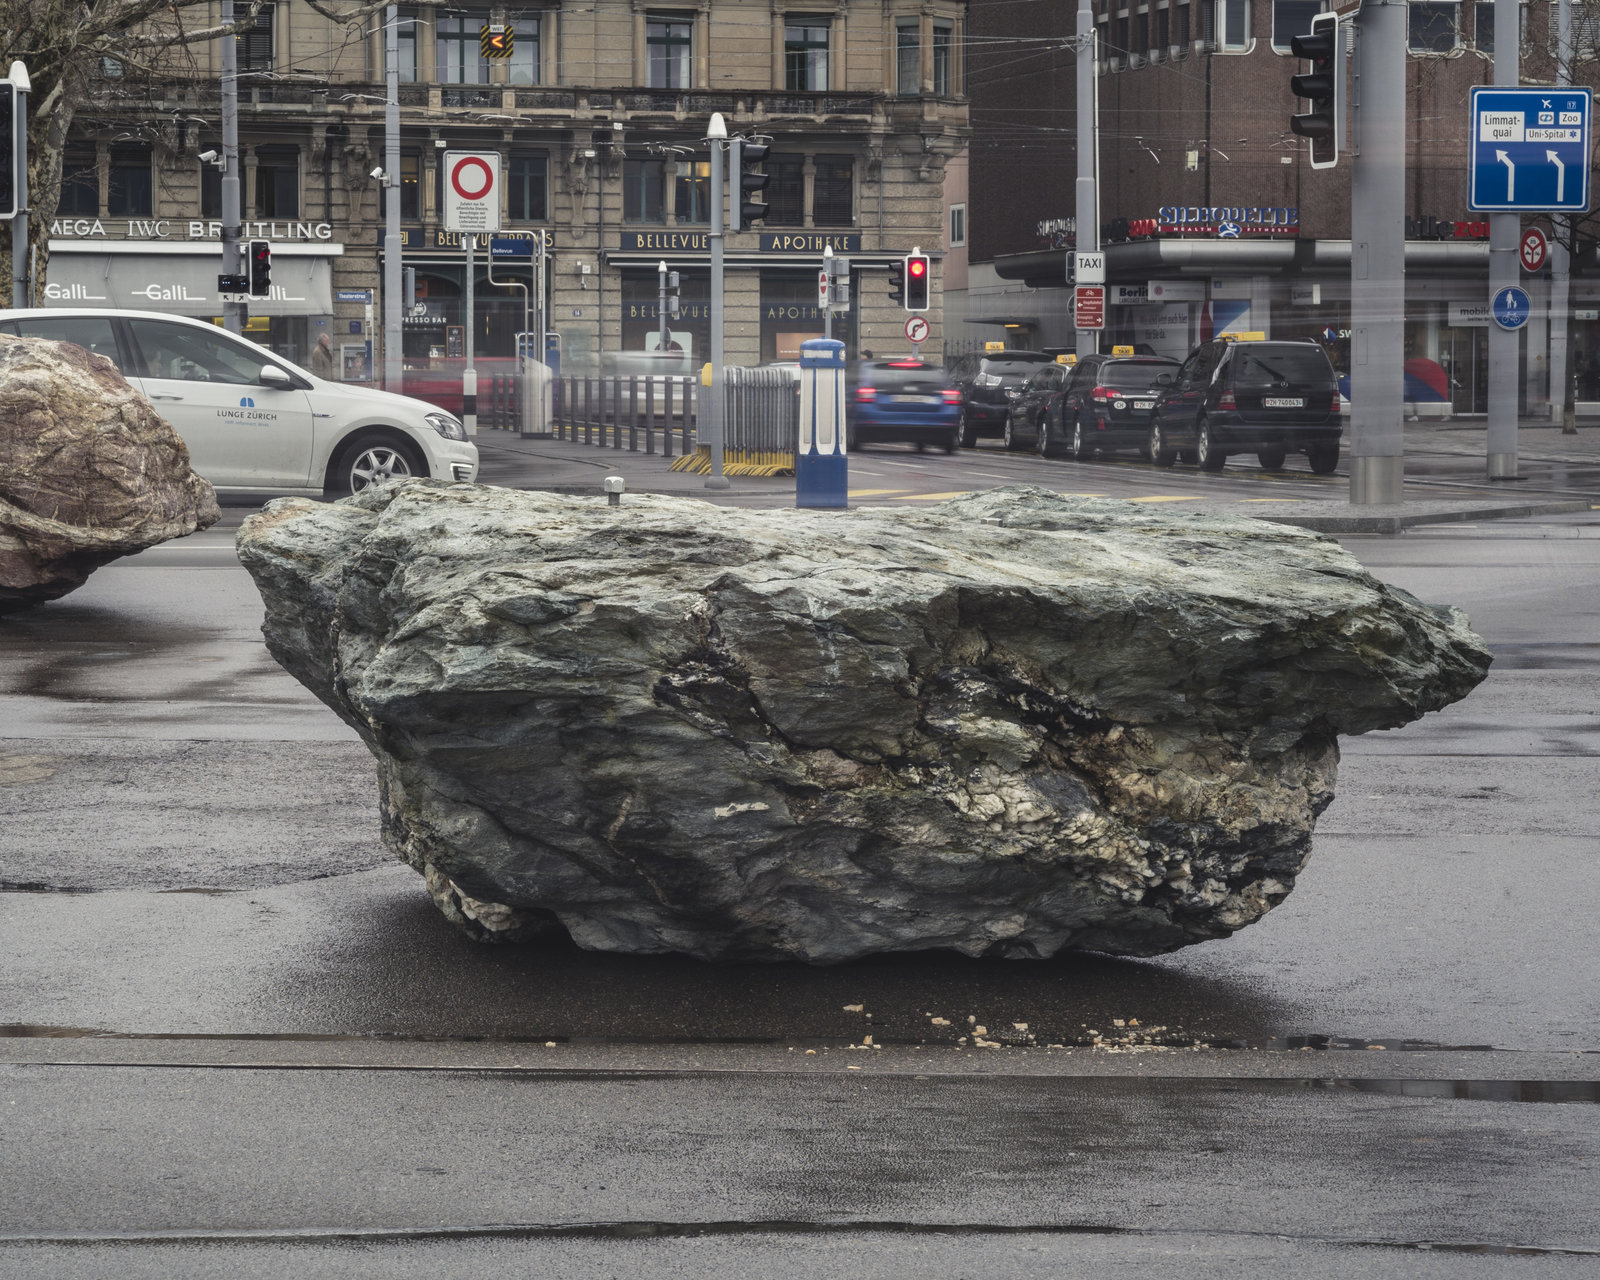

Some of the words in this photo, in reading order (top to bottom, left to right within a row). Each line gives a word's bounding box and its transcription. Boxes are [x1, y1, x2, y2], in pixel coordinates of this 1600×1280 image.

[1485, 115, 1520, 125] Limmat-
[1562, 114, 1578, 122] Zoo
[1493, 127, 1512, 138] quai
[1529, 130, 1566, 140] Uni-Spital
[1159, 206, 1298, 224] SILHOUETTE
[50, 219, 106, 236] MEGA
[127, 220, 170, 237] IWC
[189, 221, 332, 239] BRITLING
[637, 234, 708, 249] BELLEVUE
[772, 236, 849, 250] APOTHEKE
[1079, 258, 1102, 269] TAXI
[44, 283, 106, 300] Galli
[132, 284, 206, 300] Galli
[630, 306, 709, 318] BELVUE
[217, 410, 244, 418] LUNGE
[247, 411, 277, 420] ZÜRICH
